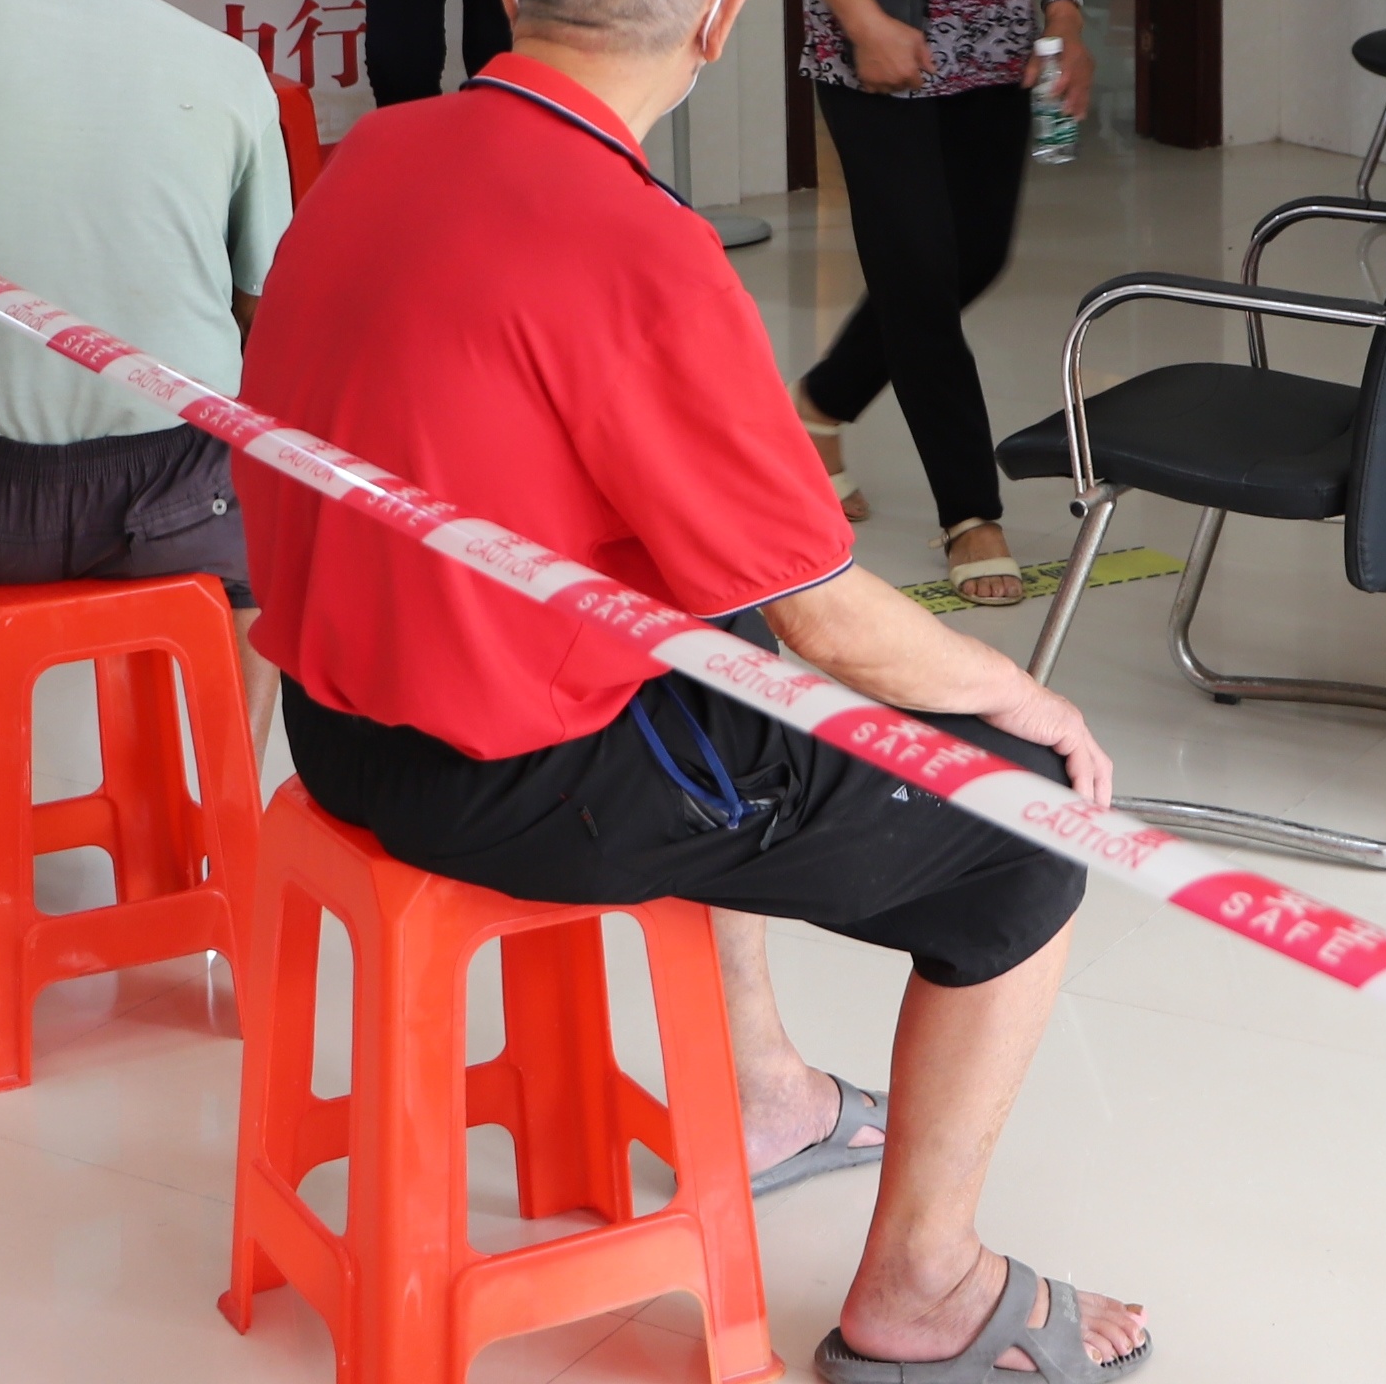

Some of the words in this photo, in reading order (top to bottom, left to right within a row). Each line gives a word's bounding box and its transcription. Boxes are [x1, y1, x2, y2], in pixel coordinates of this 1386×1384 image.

[5, 304, 49, 332] CAUTION
[63, 334, 107, 365] SAFE
[127, 368, 179, 402] CAUTION
[199, 405, 246, 439] SAFE
[278, 445, 337, 485] CAUTION
[366, 492, 424, 527] SAFE
[465, 537, 542, 584] CAUTION
[576, 589, 653, 639] SAFE
[705, 652, 805, 708] CAUTION
[851, 719, 950, 779] SAFE
[1020, 798, 1155, 871] CAUTION
[1219, 890, 1354, 966] SAFE
